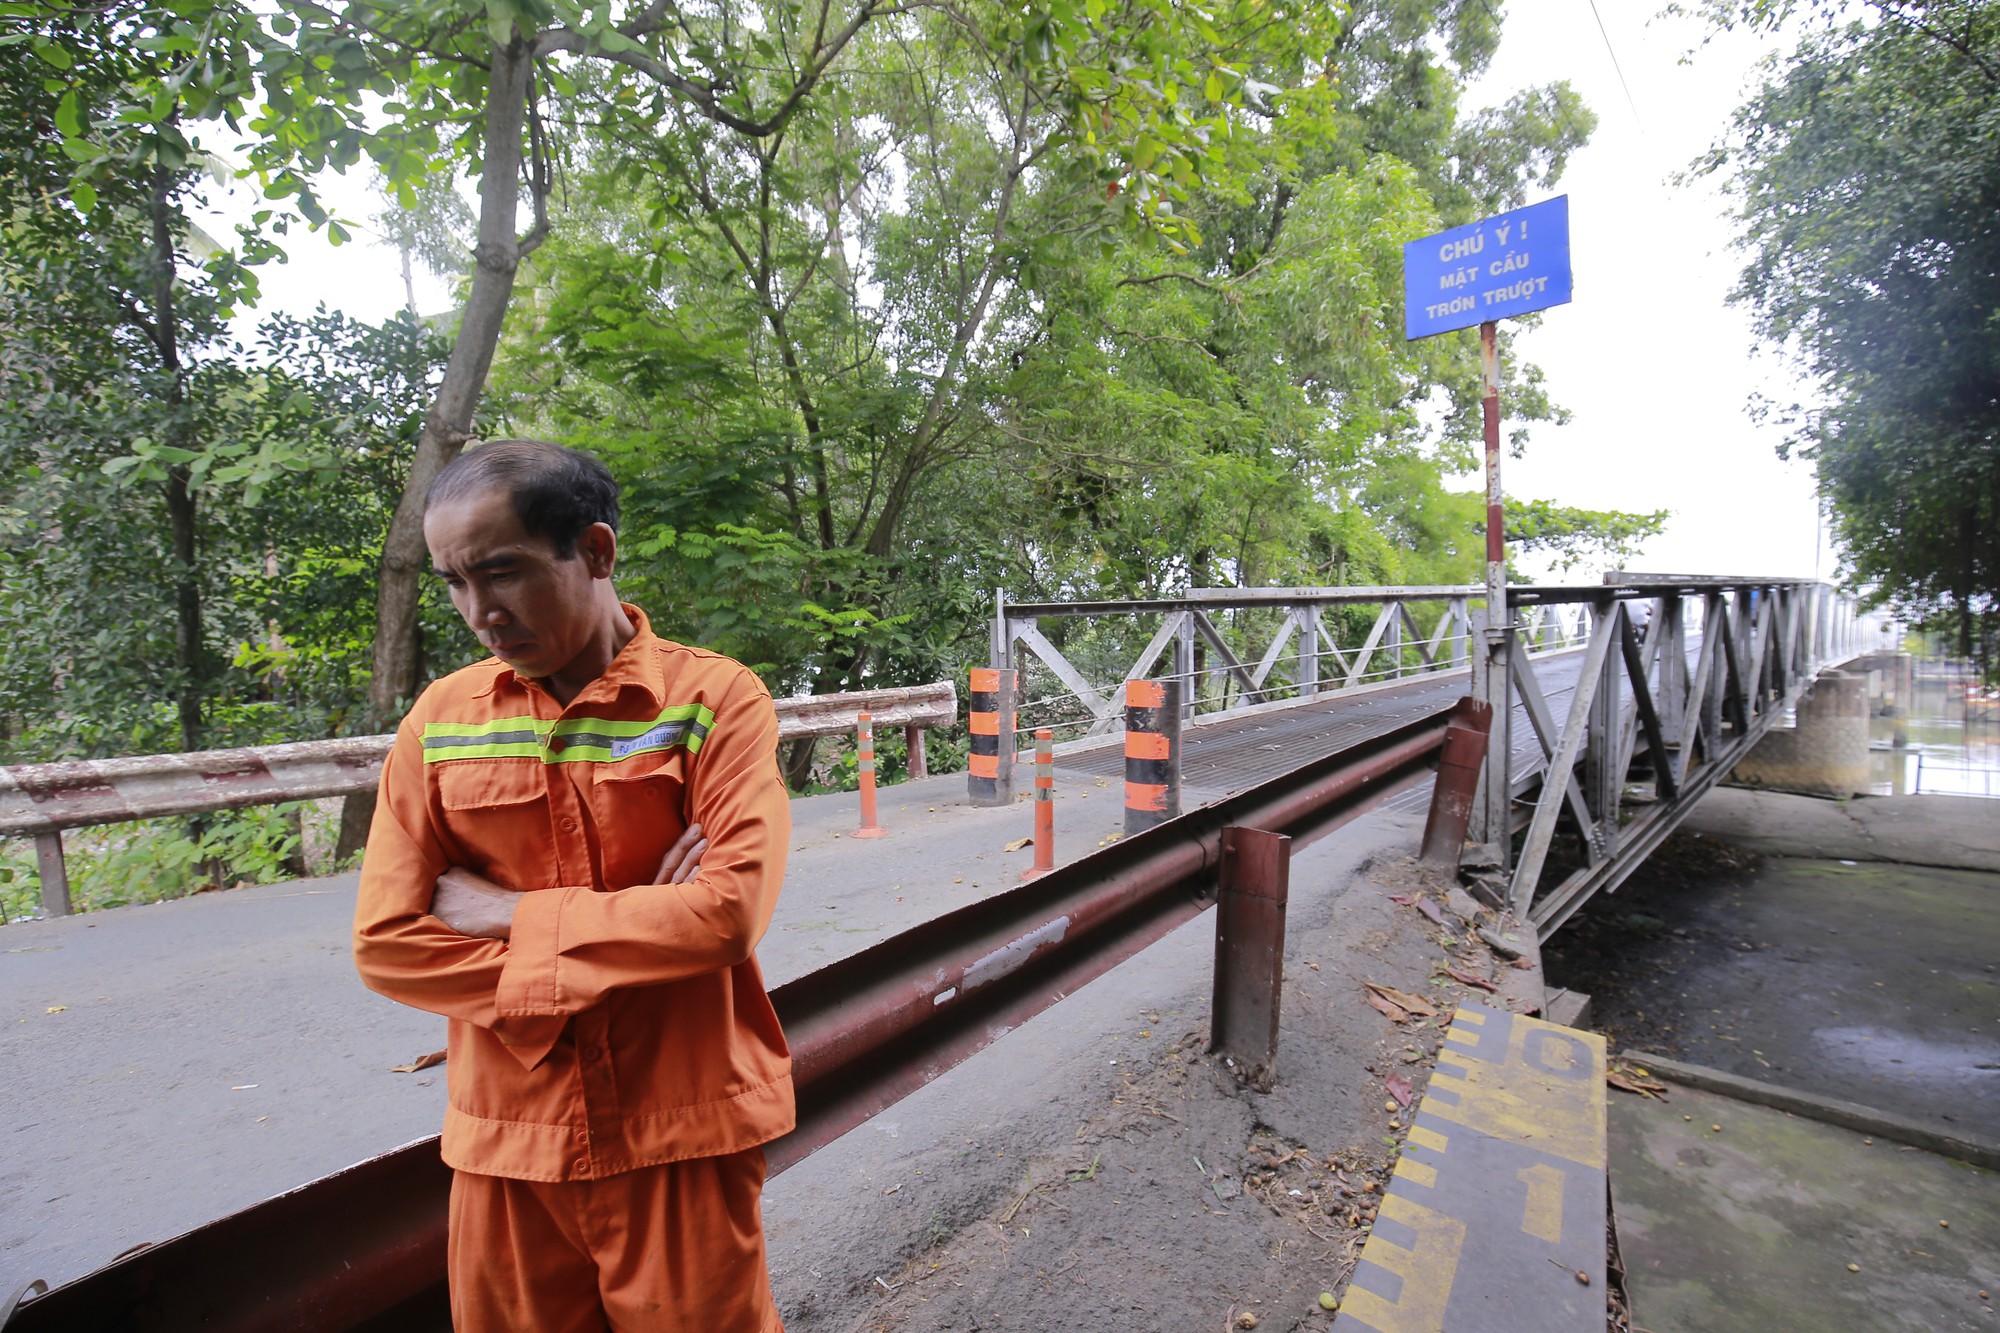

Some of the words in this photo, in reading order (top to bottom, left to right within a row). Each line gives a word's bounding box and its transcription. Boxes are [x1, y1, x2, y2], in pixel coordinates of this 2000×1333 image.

[1439, 228, 1484, 262] CHÚ
[1495, 220, 1511, 246] Ý
[1520, 220, 1528, 240] !
[1440, 267, 1479, 289] MẶT
[1489, 250, 1529, 276] CẦU
[1426, 295, 1476, 319] TRƠN
[1483, 276, 1548, 305] TRƯỢT
[1515, 1163, 1564, 1244] 1
